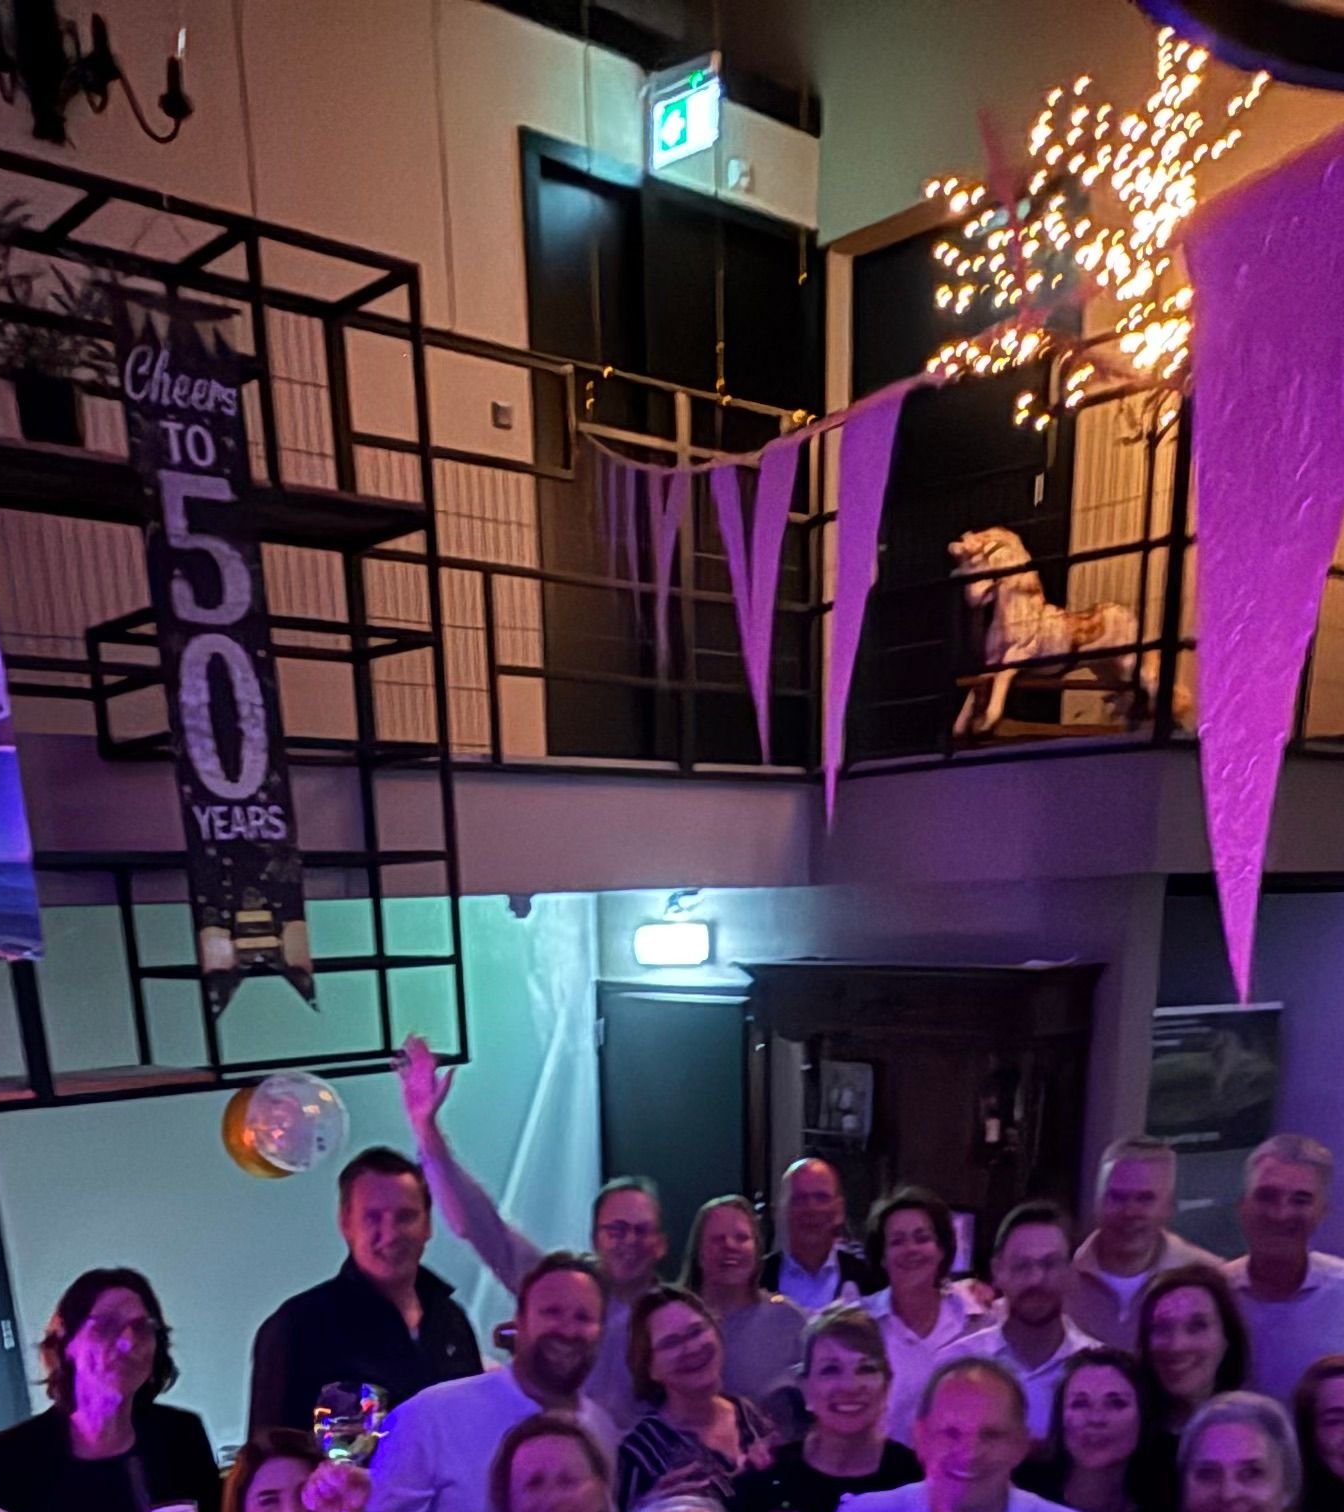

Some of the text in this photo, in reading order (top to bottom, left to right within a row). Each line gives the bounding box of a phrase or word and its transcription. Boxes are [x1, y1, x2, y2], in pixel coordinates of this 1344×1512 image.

[123, 345, 238, 416] Cheers
[159, 419, 216, 467] TO
[192, 805, 288, 841] YEARS
